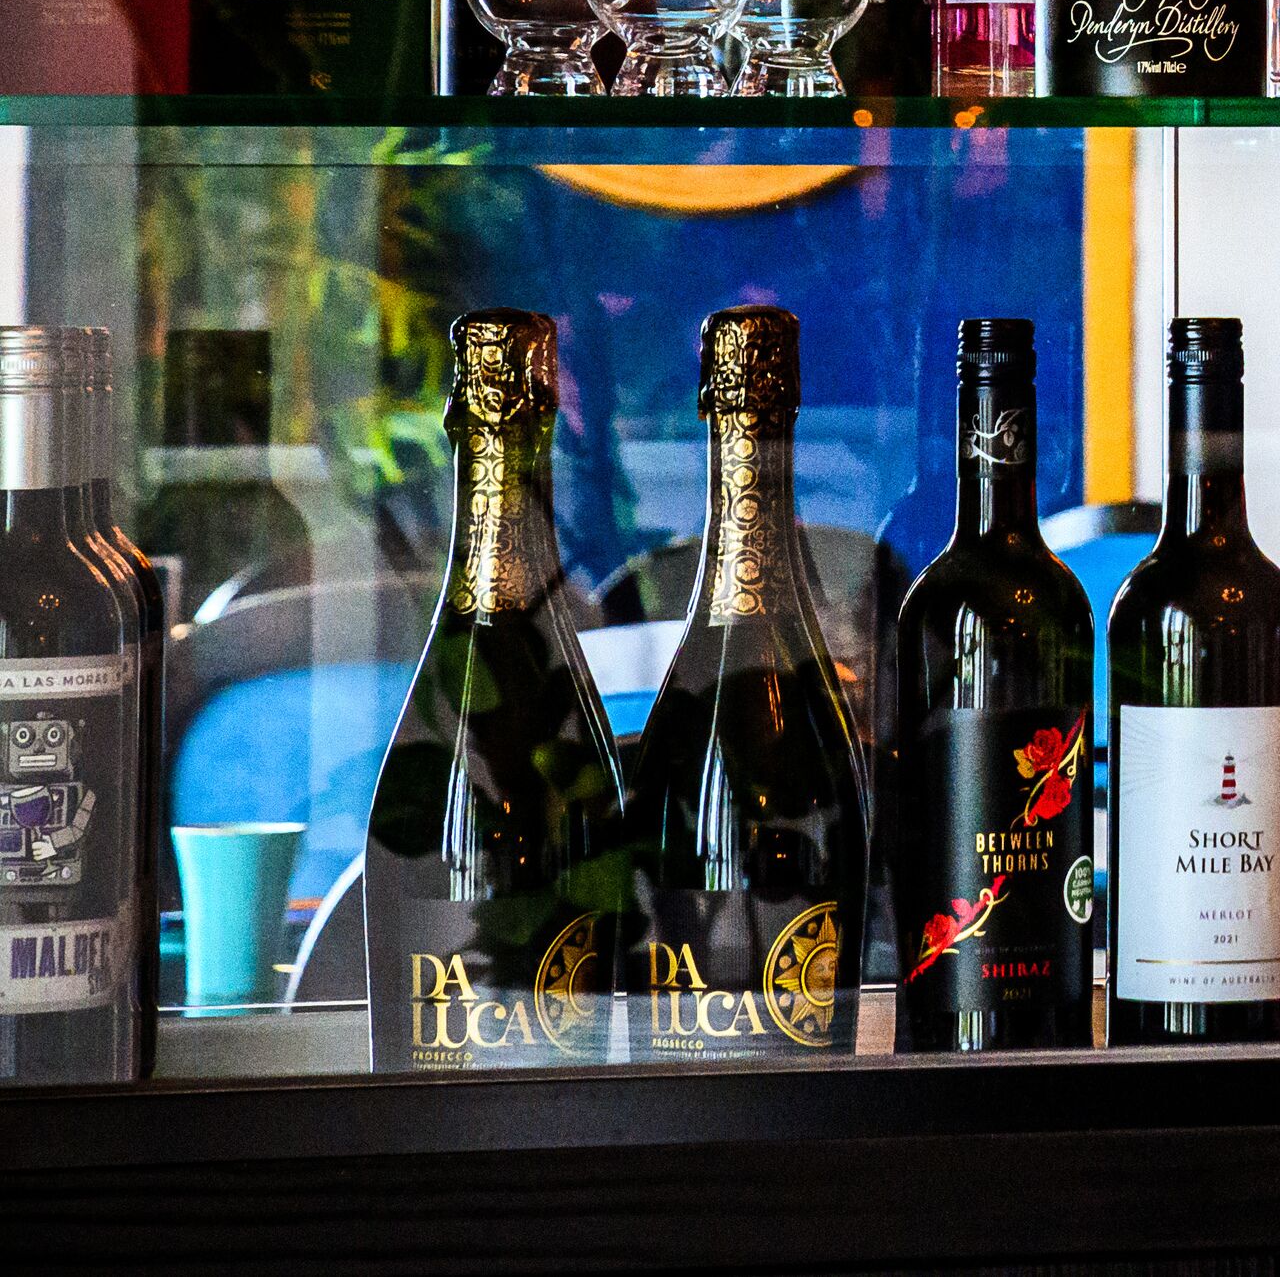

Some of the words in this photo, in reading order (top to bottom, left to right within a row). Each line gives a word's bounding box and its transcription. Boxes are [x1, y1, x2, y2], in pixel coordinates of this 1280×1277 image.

[1067, 1, 1160, 62] Penderyn
[1154, 0, 1240, 62] Distillery
[23, 676, 54, 688] LAS
[975, 830, 1054, 853] BETWEEN
[1188, 829, 1265, 851] SHORT
[982, 852, 1049, 875] THORNS
[1175, 855, 1232, 874] MILE
[1240, 853, 1275, 873] BAY
[1199, 909, 1253, 921] MERLOT
[1213, 934, 1239, 944] 2021
[649, 941, 708, 989] DA
[980, 960, 1052, 979] SHIRAZ
[412, 953, 480, 1001] DA
[1169, 977, 1196, 985] WINE
[1203, 977, 1215, 985] OF
[1221, 975, 1276, 985] AUSTRALIA
[412, 1000, 537, 1049] LUCA
[650, 990, 768, 1038] LUCA
[412, 1051, 474, 1061] PROSECCO
